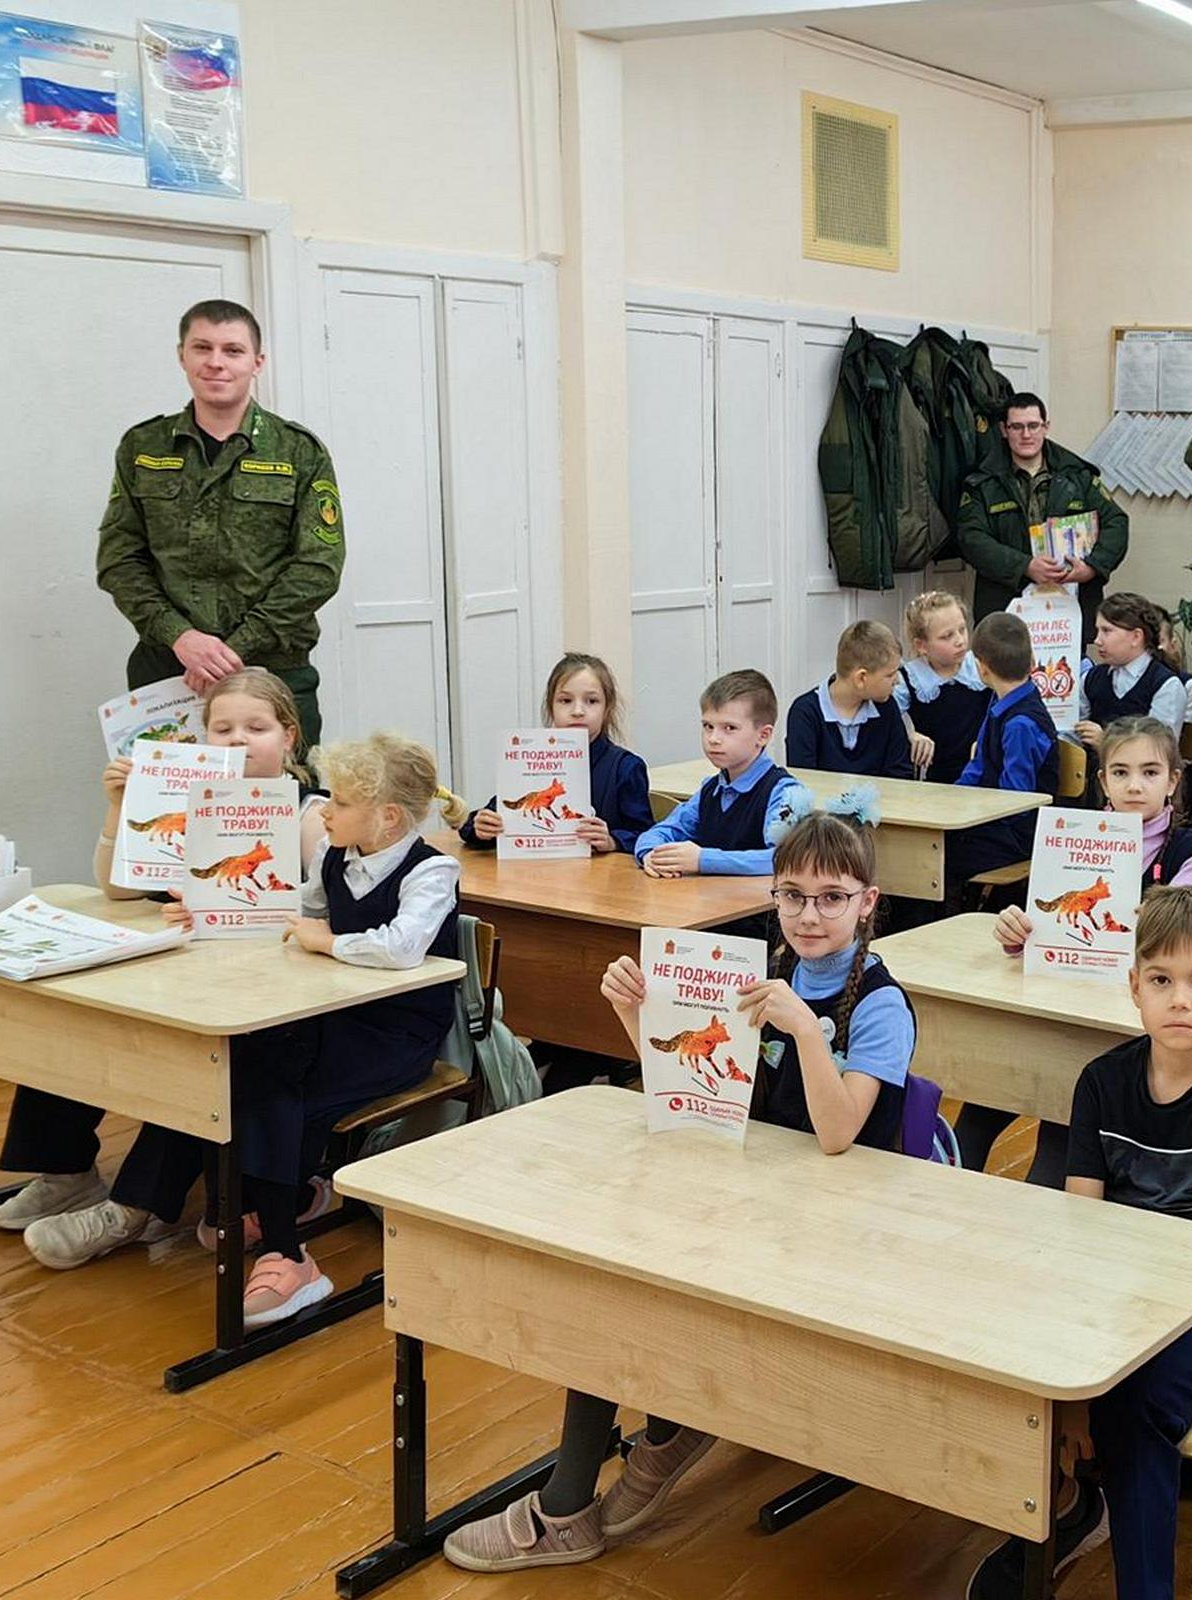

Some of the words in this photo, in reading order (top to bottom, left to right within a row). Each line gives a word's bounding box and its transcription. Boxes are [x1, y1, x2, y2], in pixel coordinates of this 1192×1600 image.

[1033, 633, 1072, 645] ОЖАРА!
[505, 751, 519, 760] НЕ
[521, 748, 583, 761] ПОДЖИГАЙ
[140, 765, 158, 777] НЕ
[160, 766, 236, 780] ПОДЖИГАЙ
[527, 762, 563, 770] ТРАВУ!
[195, 806, 212, 818] НЕ
[215, 804, 293, 818] ПОДЖИГАЙ
[222, 819, 270, 831] ТРАВУ!
[526, 839, 544, 848] 112
[1045, 836, 1062, 848] НЕ
[1064, 837, 1137, 854] ПОДЖИГАЙ
[1069, 851, 1112, 866] ТРАВУ!
[145, 867, 170, 878] 112
[219, 913, 245, 926] 112
[1057, 951, 1079, 965] 112
[653, 963, 672, 978] НЕ
[673, 965, 756, 990] ПОДЖИГАЙ
[677, 983, 724, 1002] ТРАВУ!
[686, 1098, 708, 1115] 112
